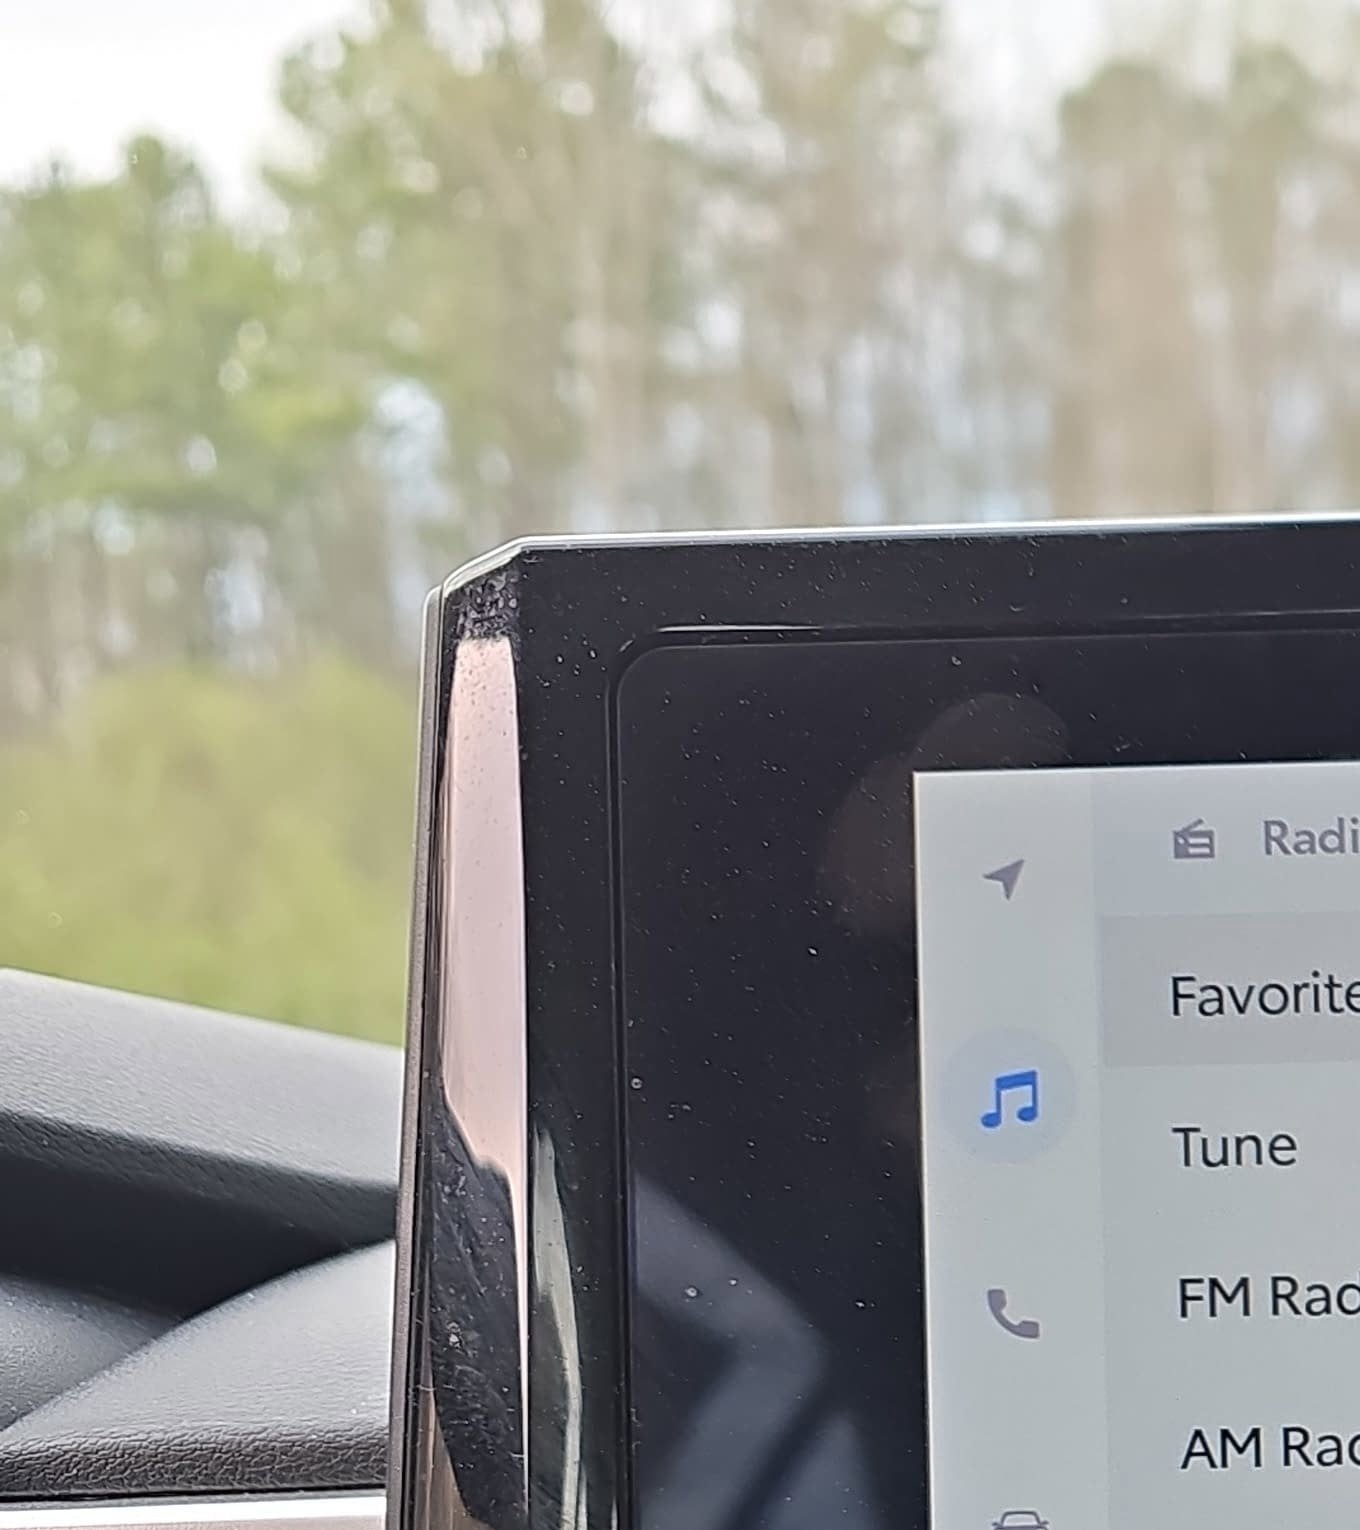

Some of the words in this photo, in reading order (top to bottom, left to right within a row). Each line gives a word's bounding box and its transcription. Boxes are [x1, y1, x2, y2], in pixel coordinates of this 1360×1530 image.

[1170, 1126, 1298, 1169] Tune
[1178, 1275, 1252, 1320] FM
[1179, 1426, 1263, 1471] AM
